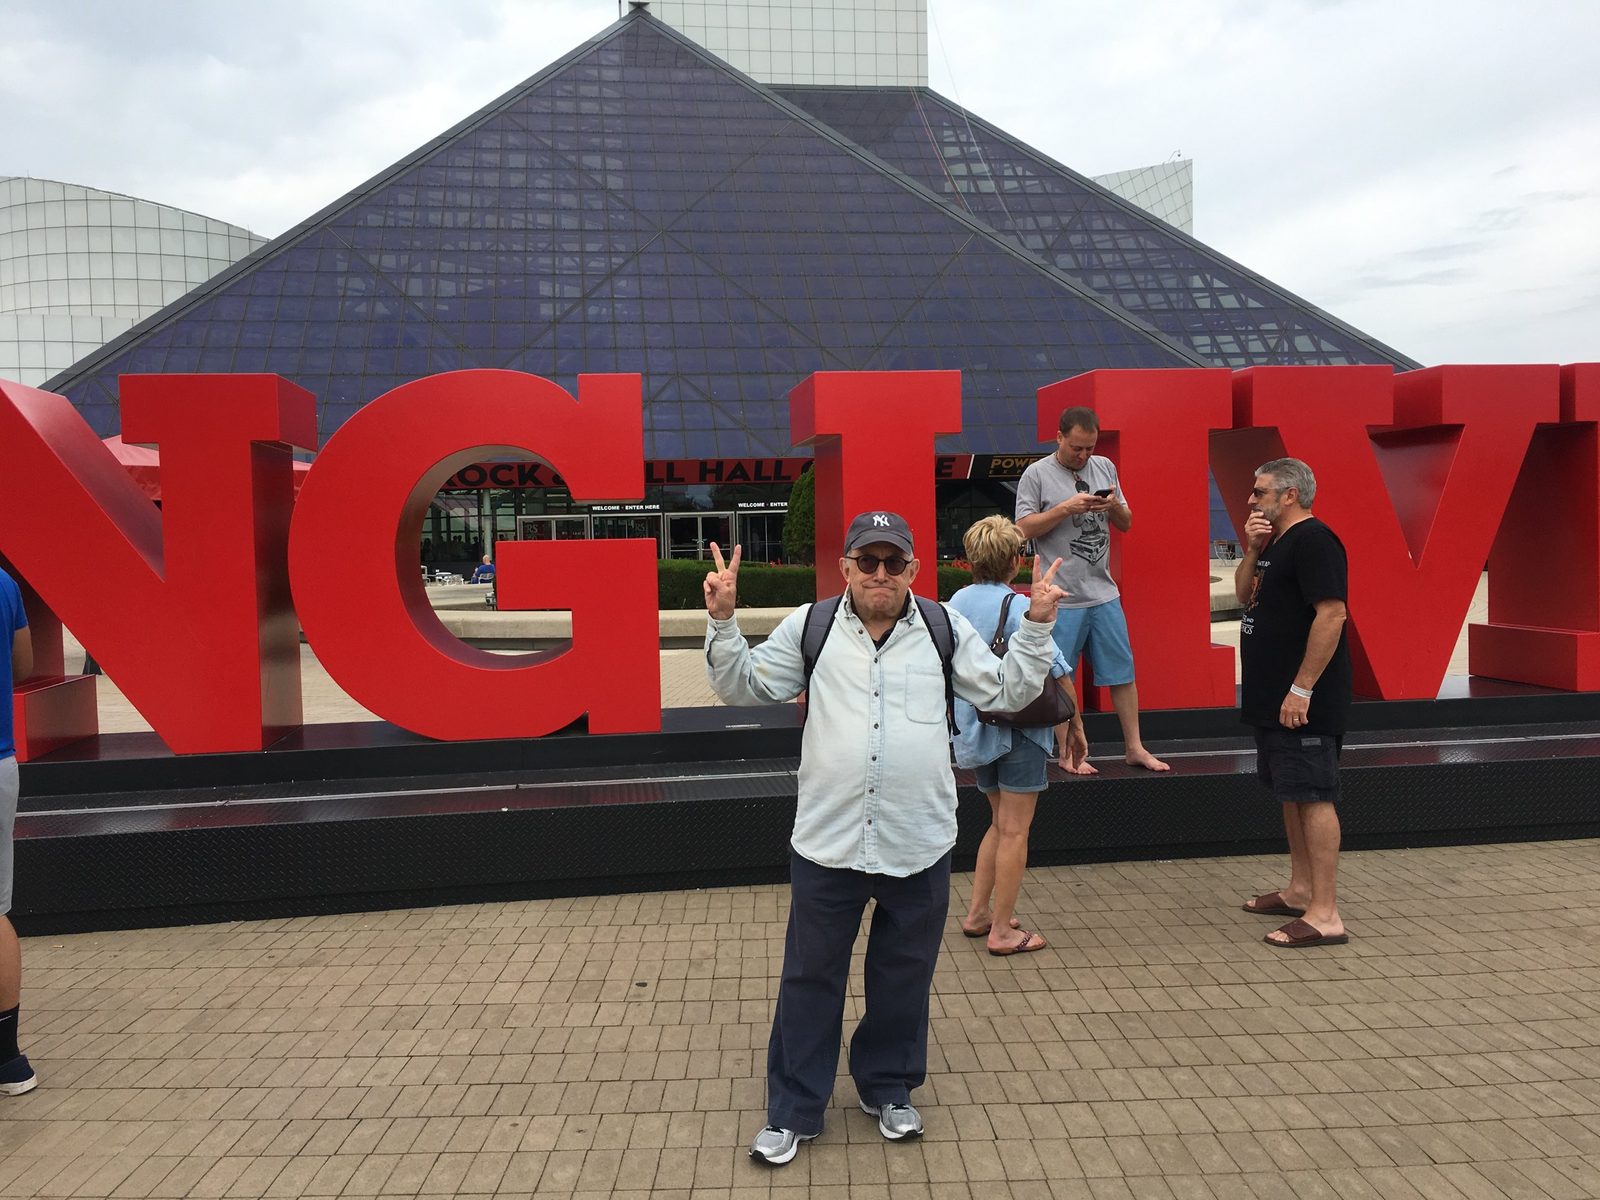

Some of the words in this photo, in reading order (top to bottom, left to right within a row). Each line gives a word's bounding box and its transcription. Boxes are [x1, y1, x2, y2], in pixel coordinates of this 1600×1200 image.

[447, 463, 545, 486] OCK
[645, 462, 685, 483] LL
[700, 460, 791, 482] HALL
[873, 514, 890, 527] NY
